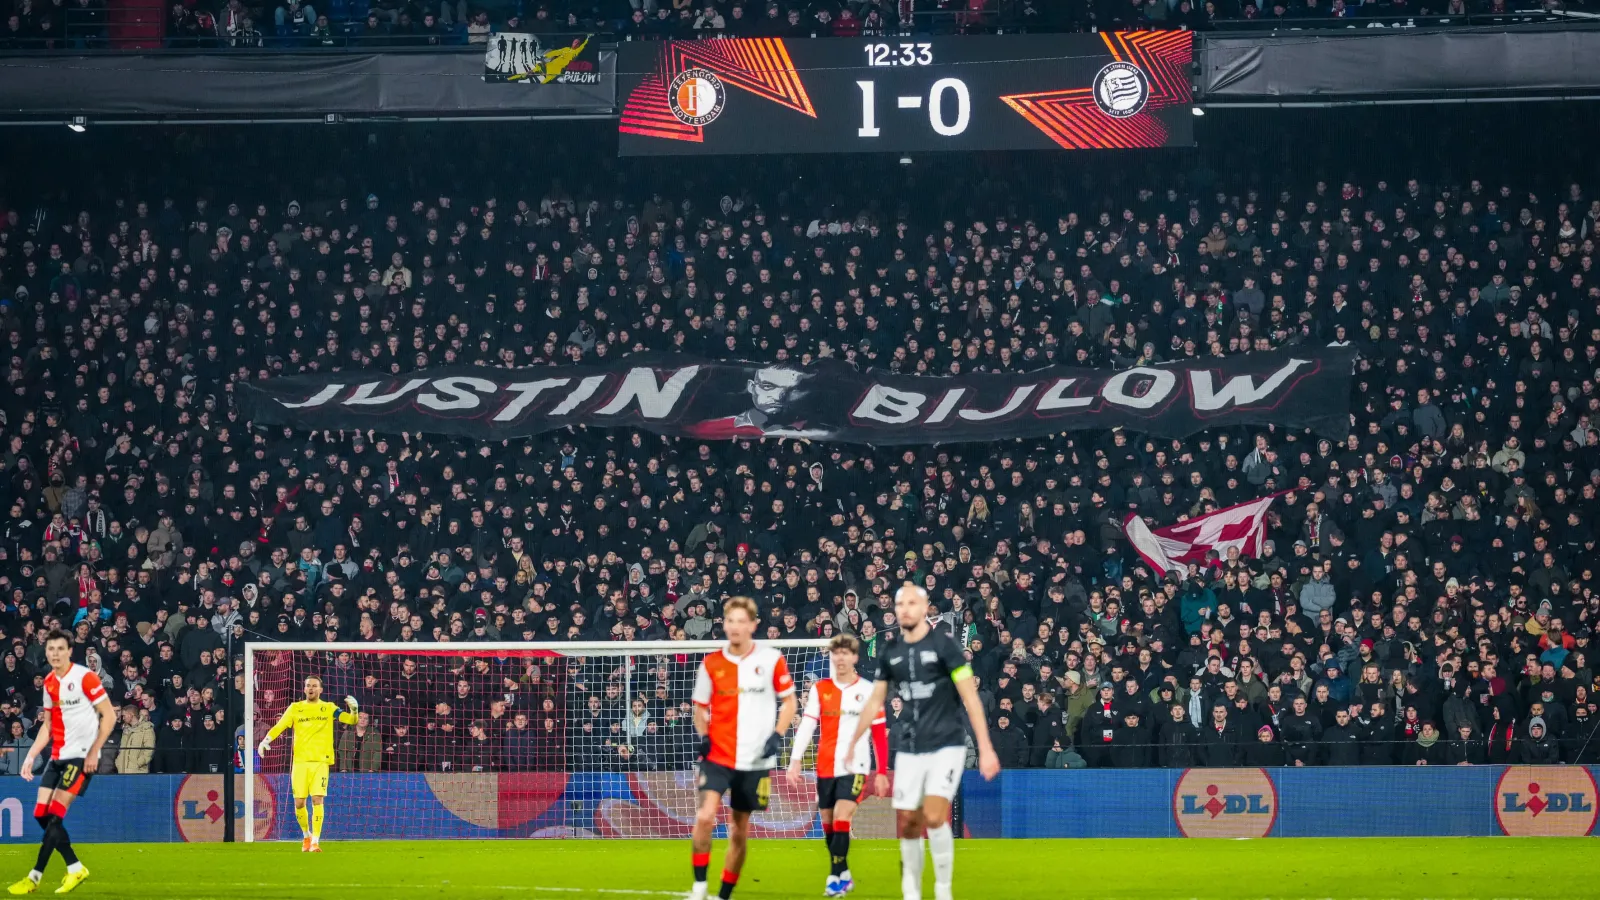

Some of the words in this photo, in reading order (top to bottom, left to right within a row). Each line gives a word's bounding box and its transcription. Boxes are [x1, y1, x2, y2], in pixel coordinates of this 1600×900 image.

[864, 43, 933, 66] 12:33
[672, 70, 721, 90] FEYENOORD
[672, 104, 721, 124] ROTTERDAM
[856, 80, 880, 137] 1
[929, 77, 971, 136] 0
[273, 365, 700, 421] JUSTIN
[851, 358, 1312, 424] BIJLOW
